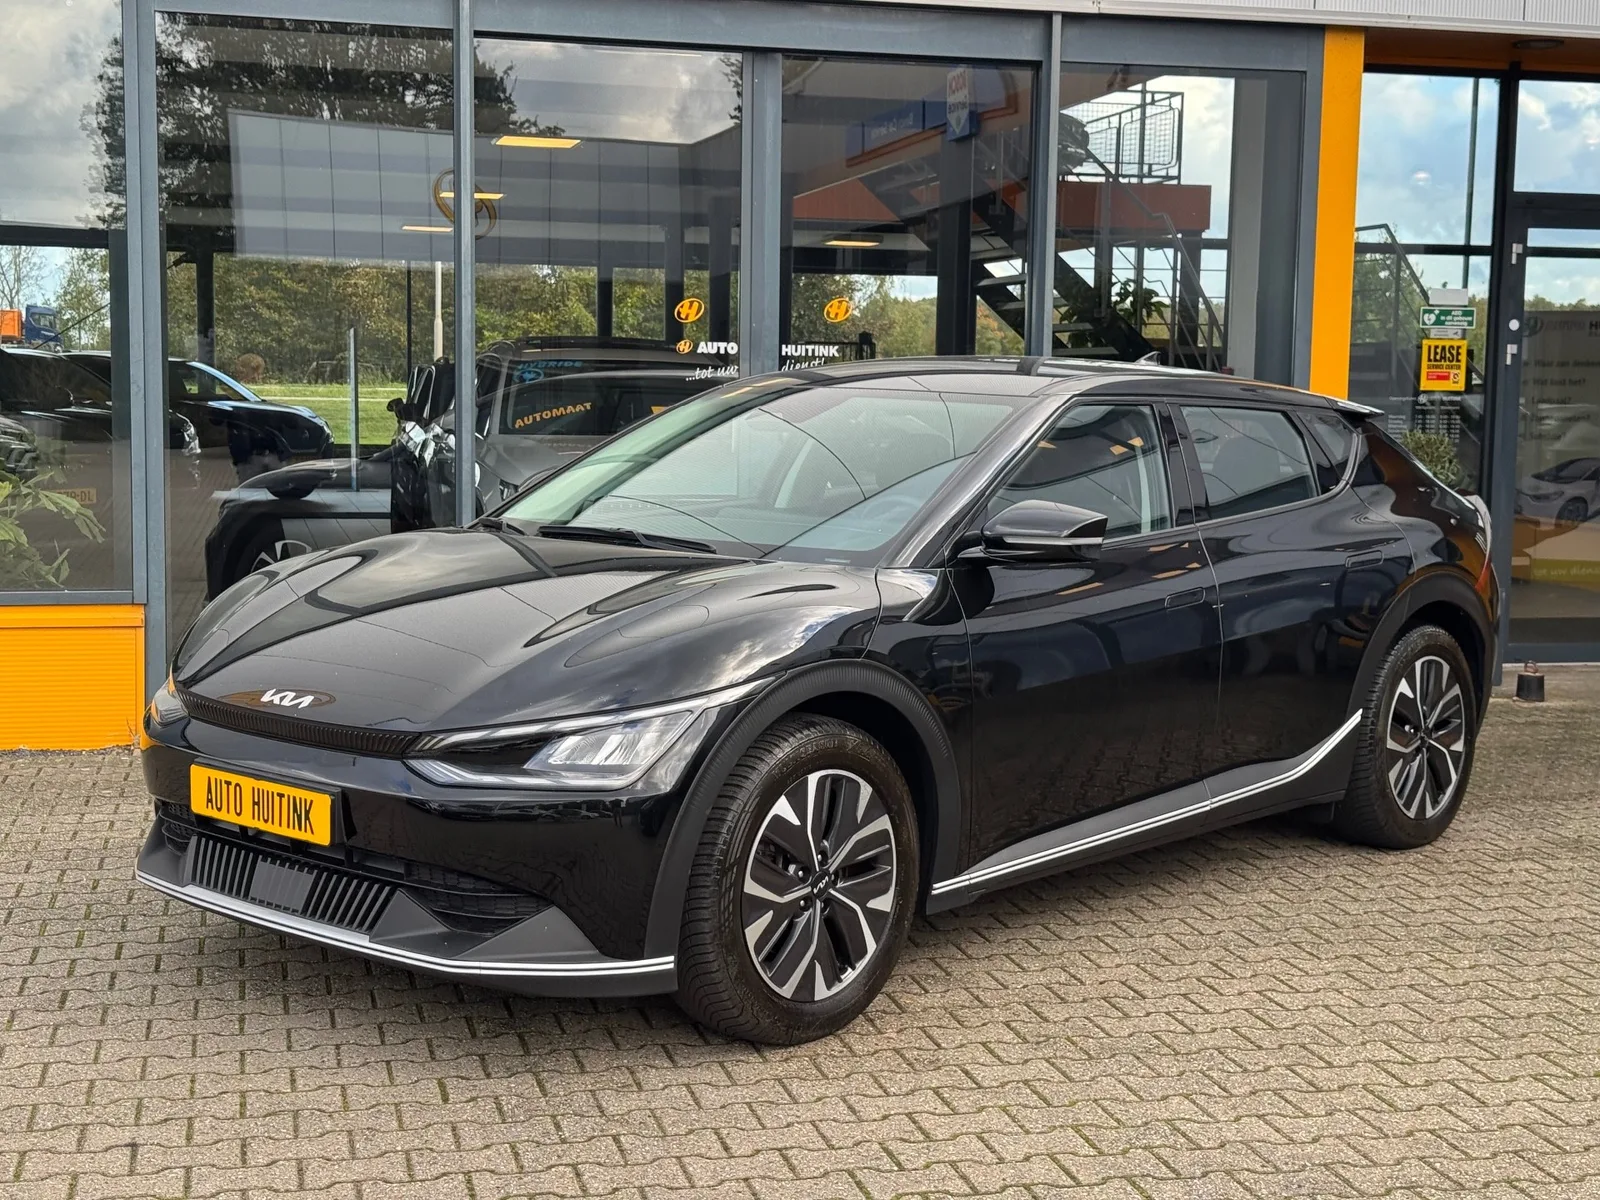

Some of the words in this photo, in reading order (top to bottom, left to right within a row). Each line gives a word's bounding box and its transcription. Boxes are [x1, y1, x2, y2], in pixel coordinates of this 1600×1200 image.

[697, 342, 738, 354] AUTO
[782, 344, 840, 358] HUITINK
[1428, 345, 1462, 363] LEASE
[716, 364, 739, 376] uw
[514, 402, 592, 428] AUTOMAAT
[206, 776, 242, 817] AUTO
[252, 786, 314, 836] HUITINK
